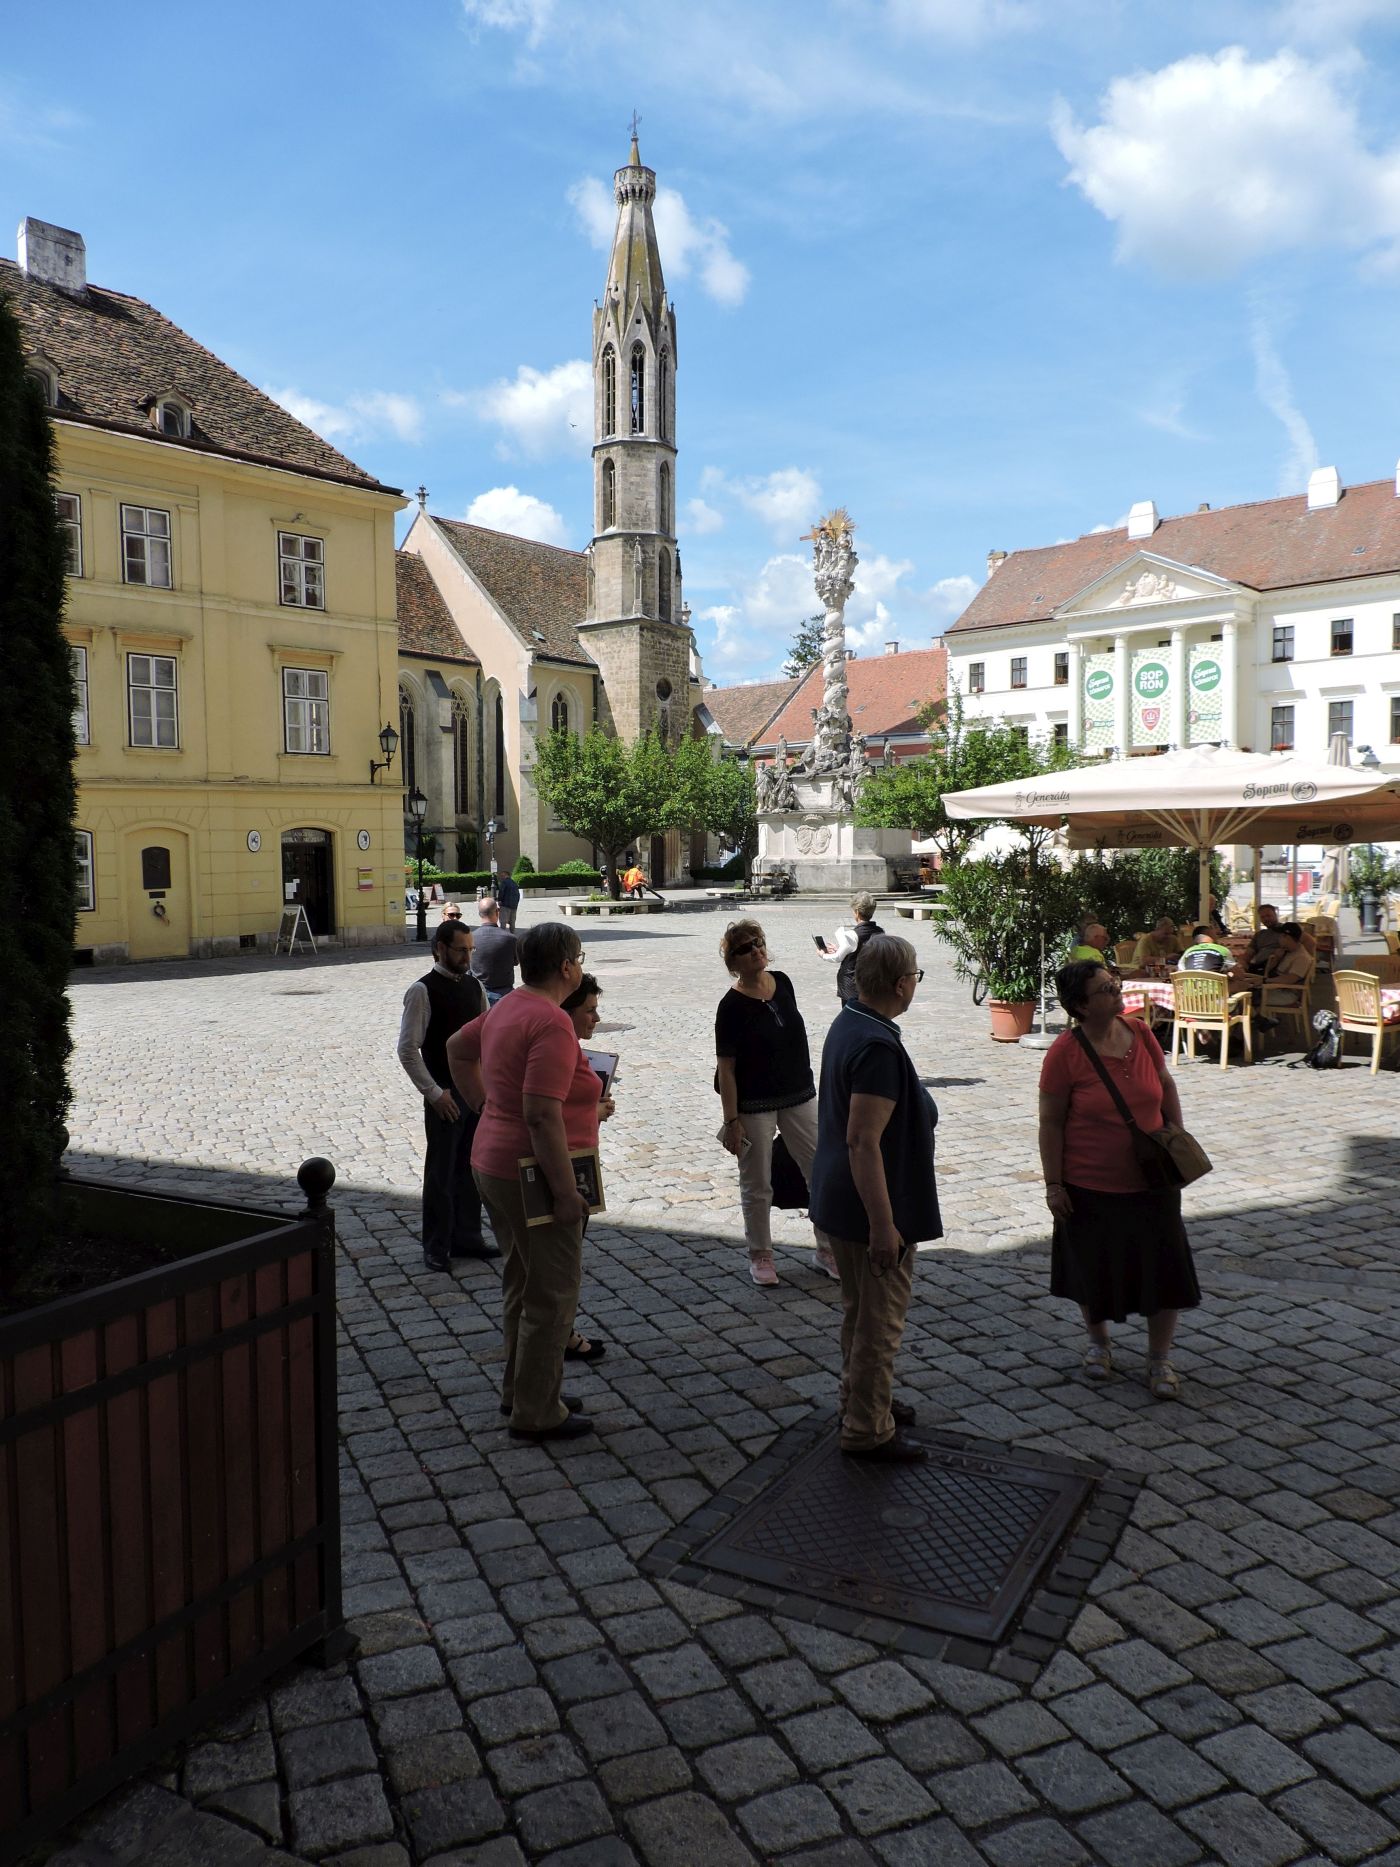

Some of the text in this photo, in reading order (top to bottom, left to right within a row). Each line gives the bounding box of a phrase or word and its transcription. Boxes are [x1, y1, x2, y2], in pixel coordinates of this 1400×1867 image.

[1140, 670, 1164, 680] SOP
[1139, 680, 1164, 690] RON
[1243, 782, 1290, 800] Soproni
[1026, 790, 1070, 808] Generális
